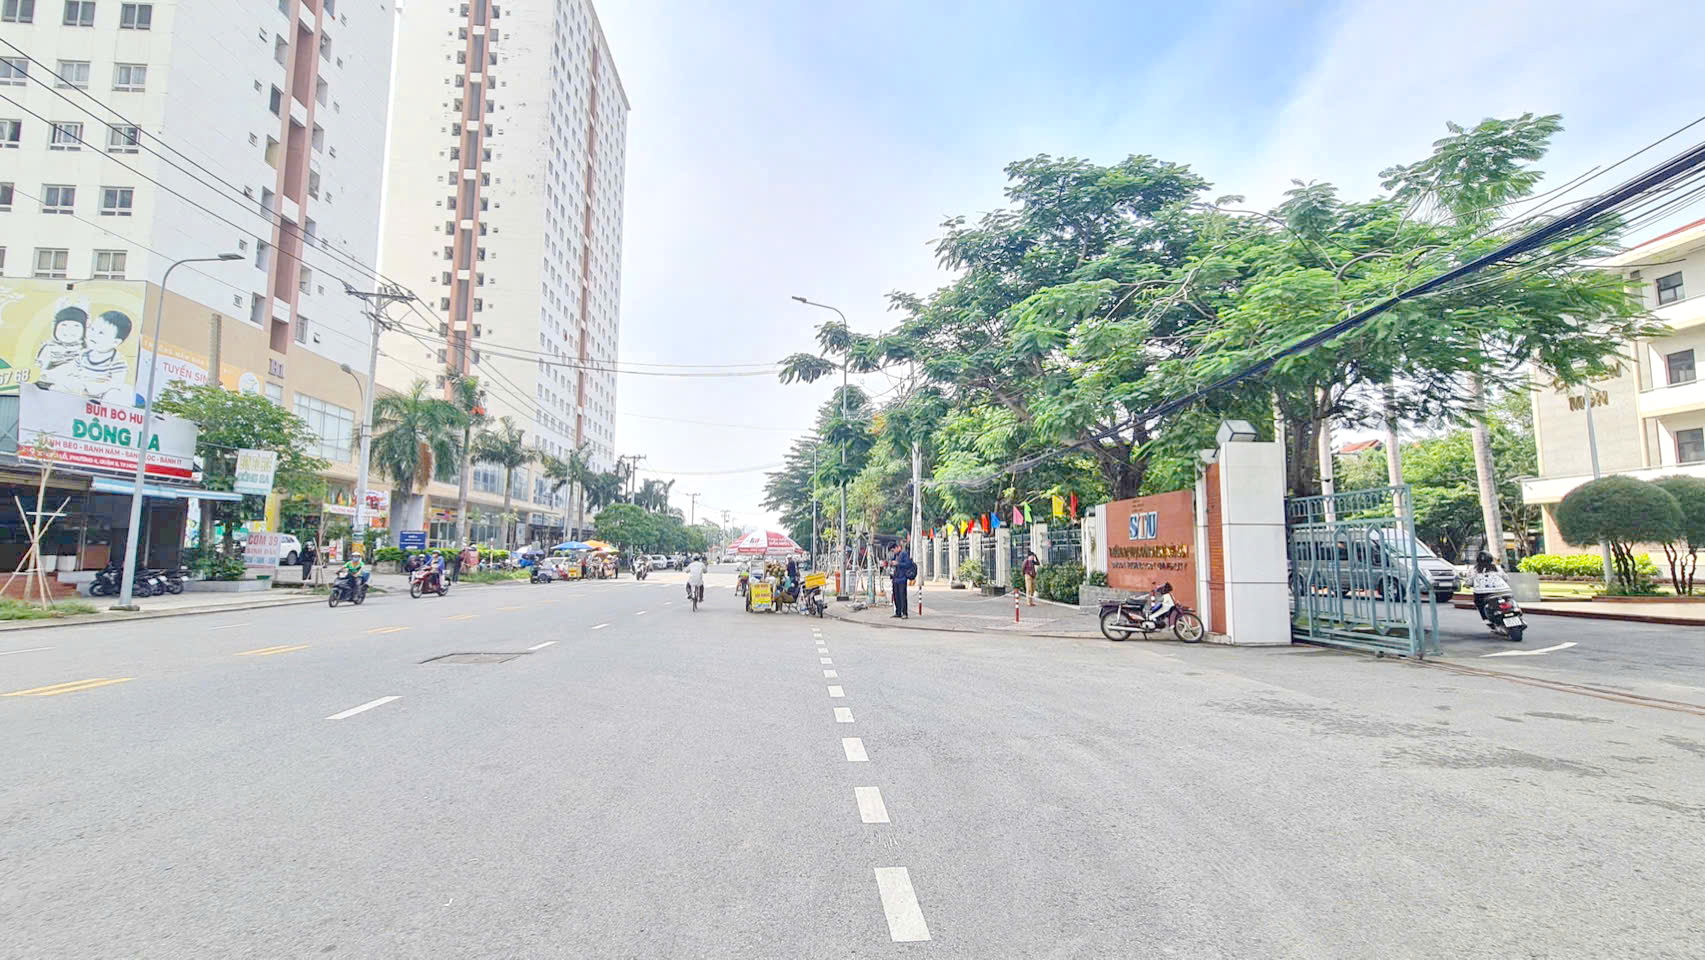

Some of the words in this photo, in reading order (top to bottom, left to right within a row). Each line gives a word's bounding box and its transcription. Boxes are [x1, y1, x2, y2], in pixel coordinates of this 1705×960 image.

[15, 368, 31, 384] 68
[194, 372, 209, 383] SIN
[129, 411, 144, 425] HU
[72, 417, 132, 447] ĐÔNG
[1129, 513, 1157, 539] STU
